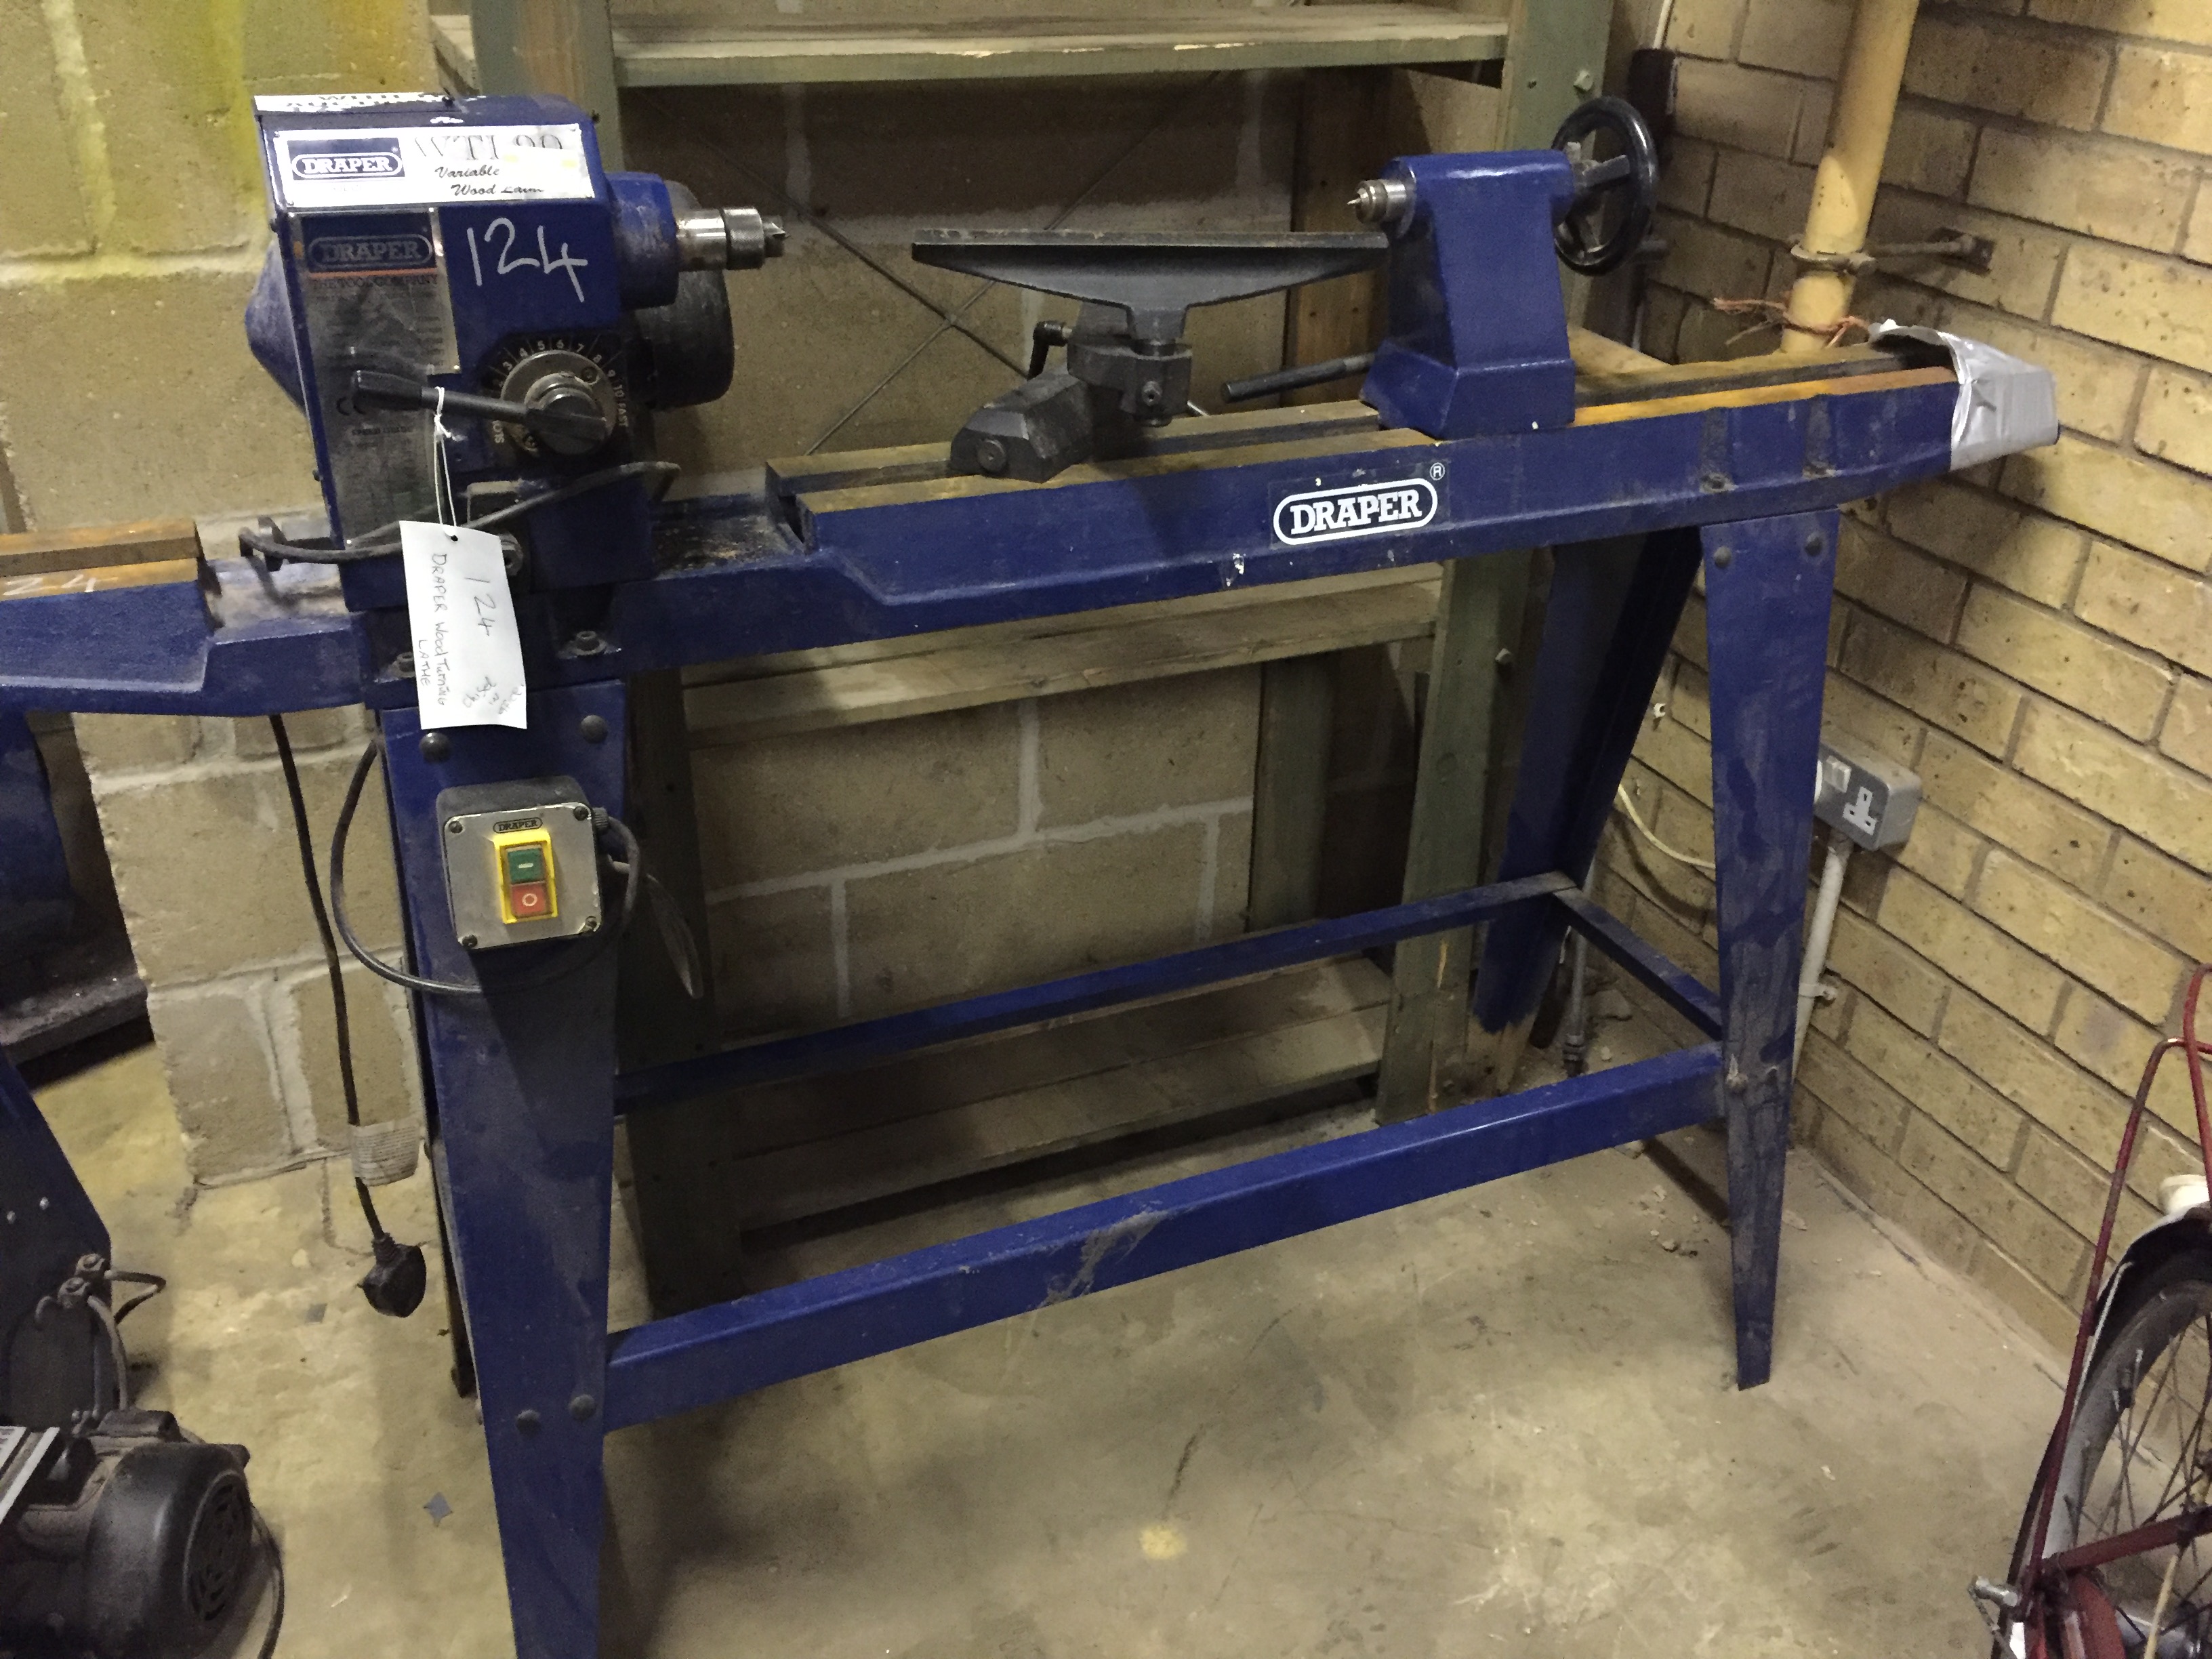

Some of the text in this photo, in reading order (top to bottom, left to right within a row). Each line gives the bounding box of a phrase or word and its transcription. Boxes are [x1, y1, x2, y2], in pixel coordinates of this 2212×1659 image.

[302, 156, 393, 173] DRAPER
[434, 165, 499, 178] Variable
[451, 184, 496, 196] Wood
[321, 241, 422, 262] DRAPER
[466, 217, 588, 304] 124
[537, 340, 546, 350] 5
[556, 340, 565, 349] 6
[577, 343, 584, 352] 7
[1289, 489, 1422, 535] DRAPER
[432, 553, 448, 613] DRAPER
[464, 577, 496, 636] 124
[418, 639, 431, 687] LATHE
[498, 819, 537, 832] DRAPER
